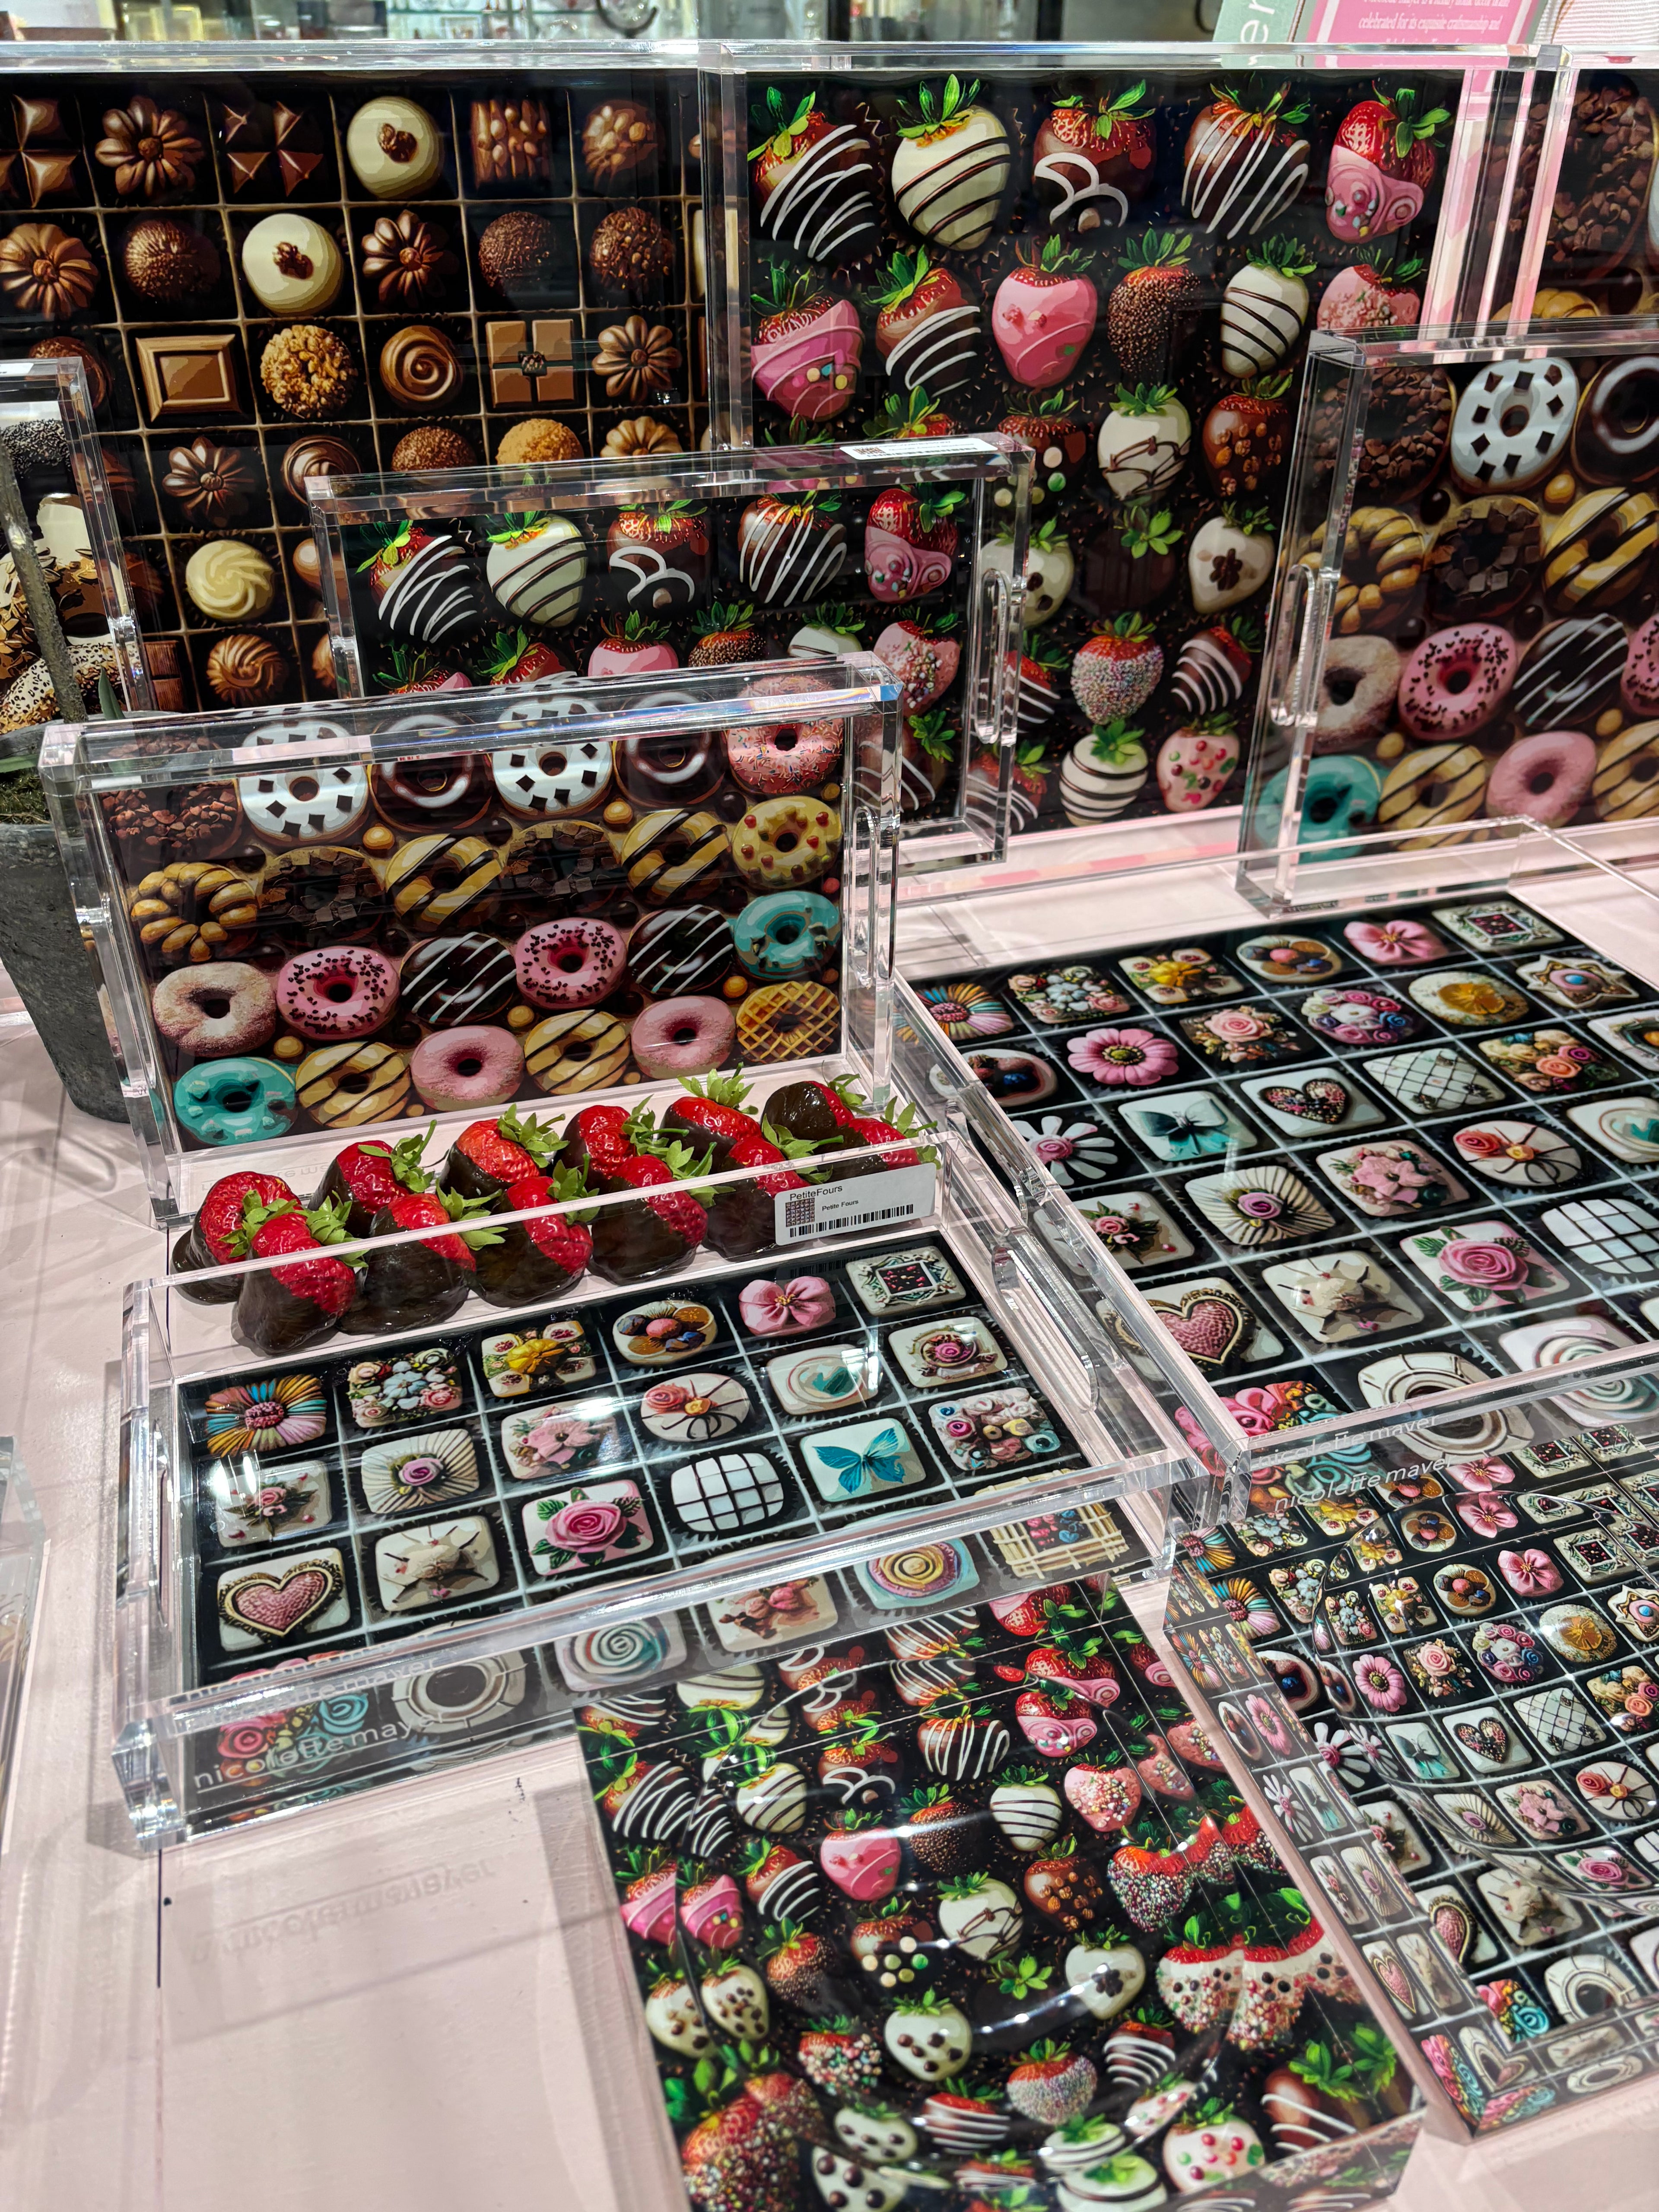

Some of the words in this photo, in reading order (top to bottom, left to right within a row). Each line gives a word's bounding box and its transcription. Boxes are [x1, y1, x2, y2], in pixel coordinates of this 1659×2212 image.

[1358, 12, 1398, 29] celebrated
[1396, 13, 1409, 29] for
[790, 1185, 842, 1201] PetiteFours
